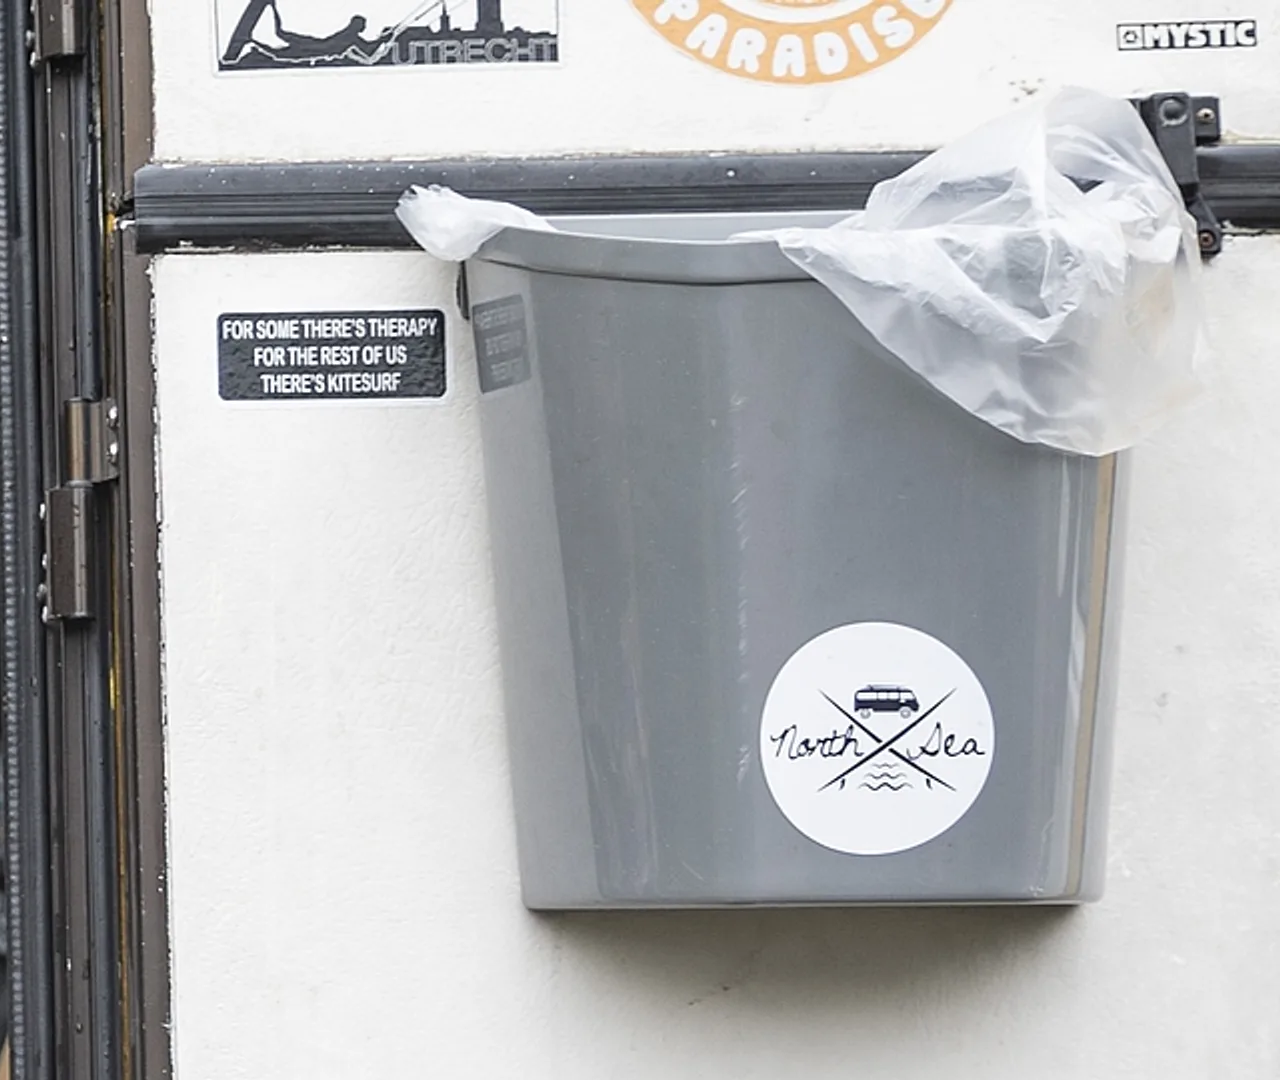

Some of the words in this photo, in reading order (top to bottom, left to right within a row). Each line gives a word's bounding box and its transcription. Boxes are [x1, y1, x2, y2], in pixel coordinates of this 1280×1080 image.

[1143, 21, 1256, 48] MYSTIC
[391, 38, 558, 66] UTRECHT
[221, 319, 255, 340] FOR
[255, 318, 300, 340] SOME
[301, 317, 366, 340] THERE'S
[367, 316, 438, 337] THERAPY
[253, 345, 286, 367] FOR
[286, 345, 319, 367] THE
[319, 345, 360, 366] REST
[361, 345, 385, 365] OF
[385, 344, 408, 365] US
[259, 372, 326, 394] THERE'S
[327, 371, 402, 392] KITESURF
[770, 723, 865, 760] North
[906, 721, 986, 761] Sea
